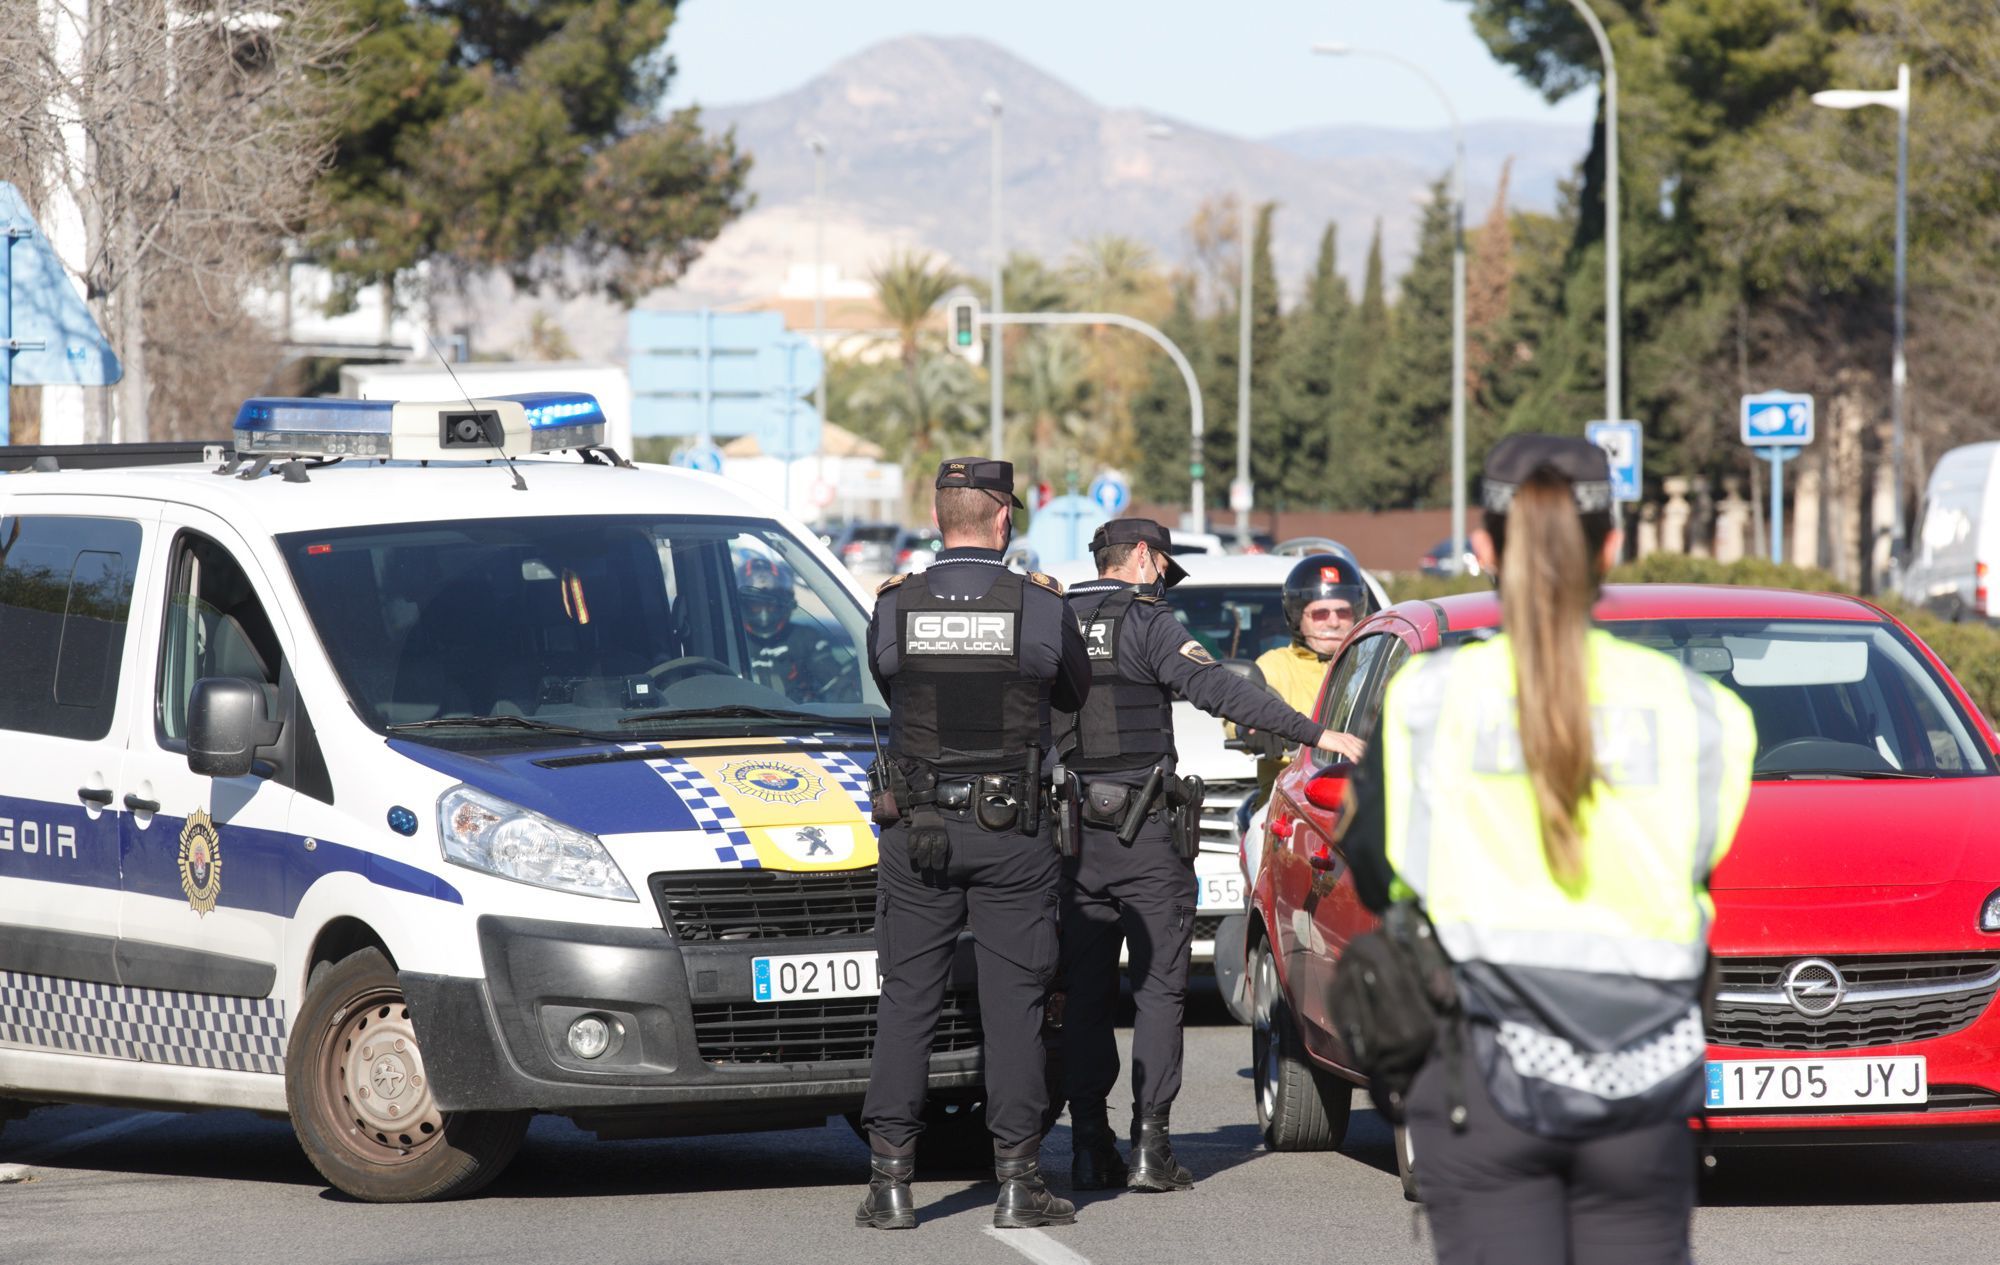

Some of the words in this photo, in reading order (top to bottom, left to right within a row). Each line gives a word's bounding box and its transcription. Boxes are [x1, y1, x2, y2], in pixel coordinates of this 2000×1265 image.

[914, 616, 1006, 639] GOIR
[909, 641, 959, 651] POLICIA
[963, 641, 1011, 651] LOCAL
[1087, 646, 1110, 656] CAL
[0, 817, 77, 859] GOIR
[1208, 880, 1240, 903] 55
[759, 983, 768, 994] E
[779, 959, 861, 994] 0210
[1710, 1089, 1720, 1100] E
[1734, 1065, 1828, 1100] 1705
[1854, 1062, 1920, 1098] JYJ
